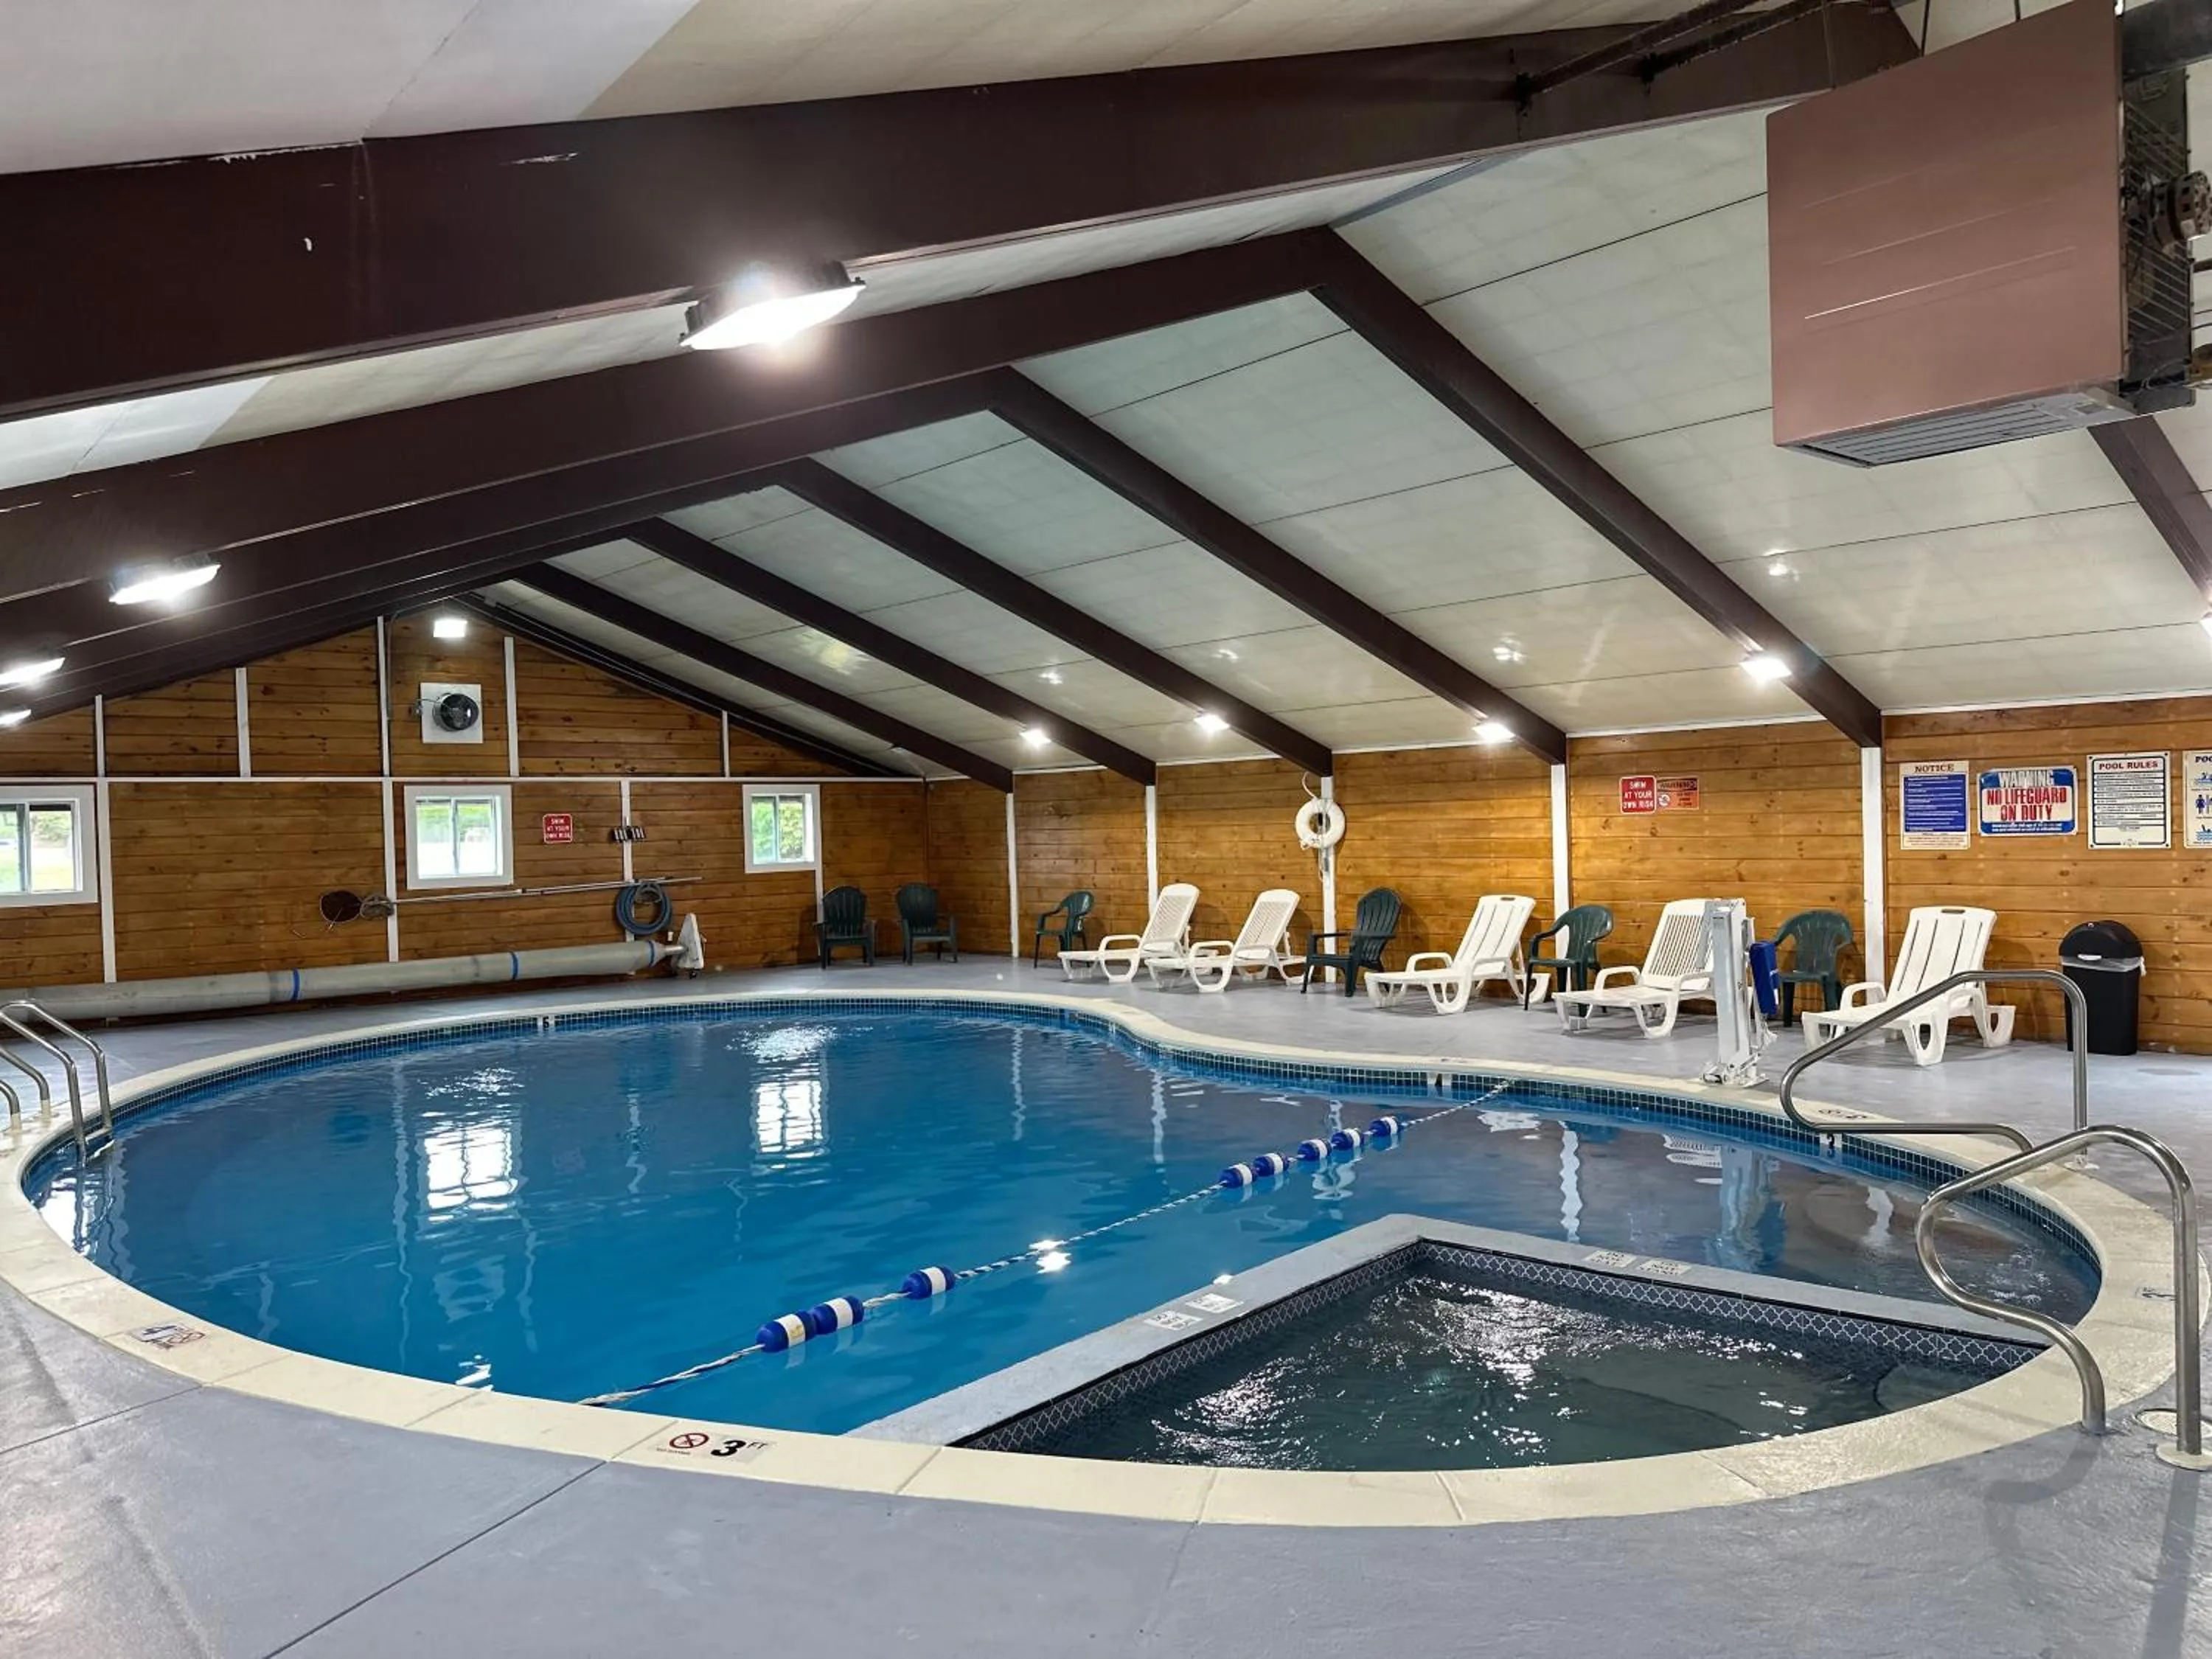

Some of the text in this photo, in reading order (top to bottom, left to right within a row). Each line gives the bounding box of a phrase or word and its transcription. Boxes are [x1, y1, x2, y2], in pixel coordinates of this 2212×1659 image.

[1915, 764, 1954, 773] NOTICE
[2098, 760, 2158, 771] POOL RULES
[1633, 790, 1652, 799] YOUR
[1987, 787, 2067, 805] NO LIFEGUARD
[2000, 804, 2053, 821] ON DUTY
[711, 1440, 768, 1456] 3 FT
